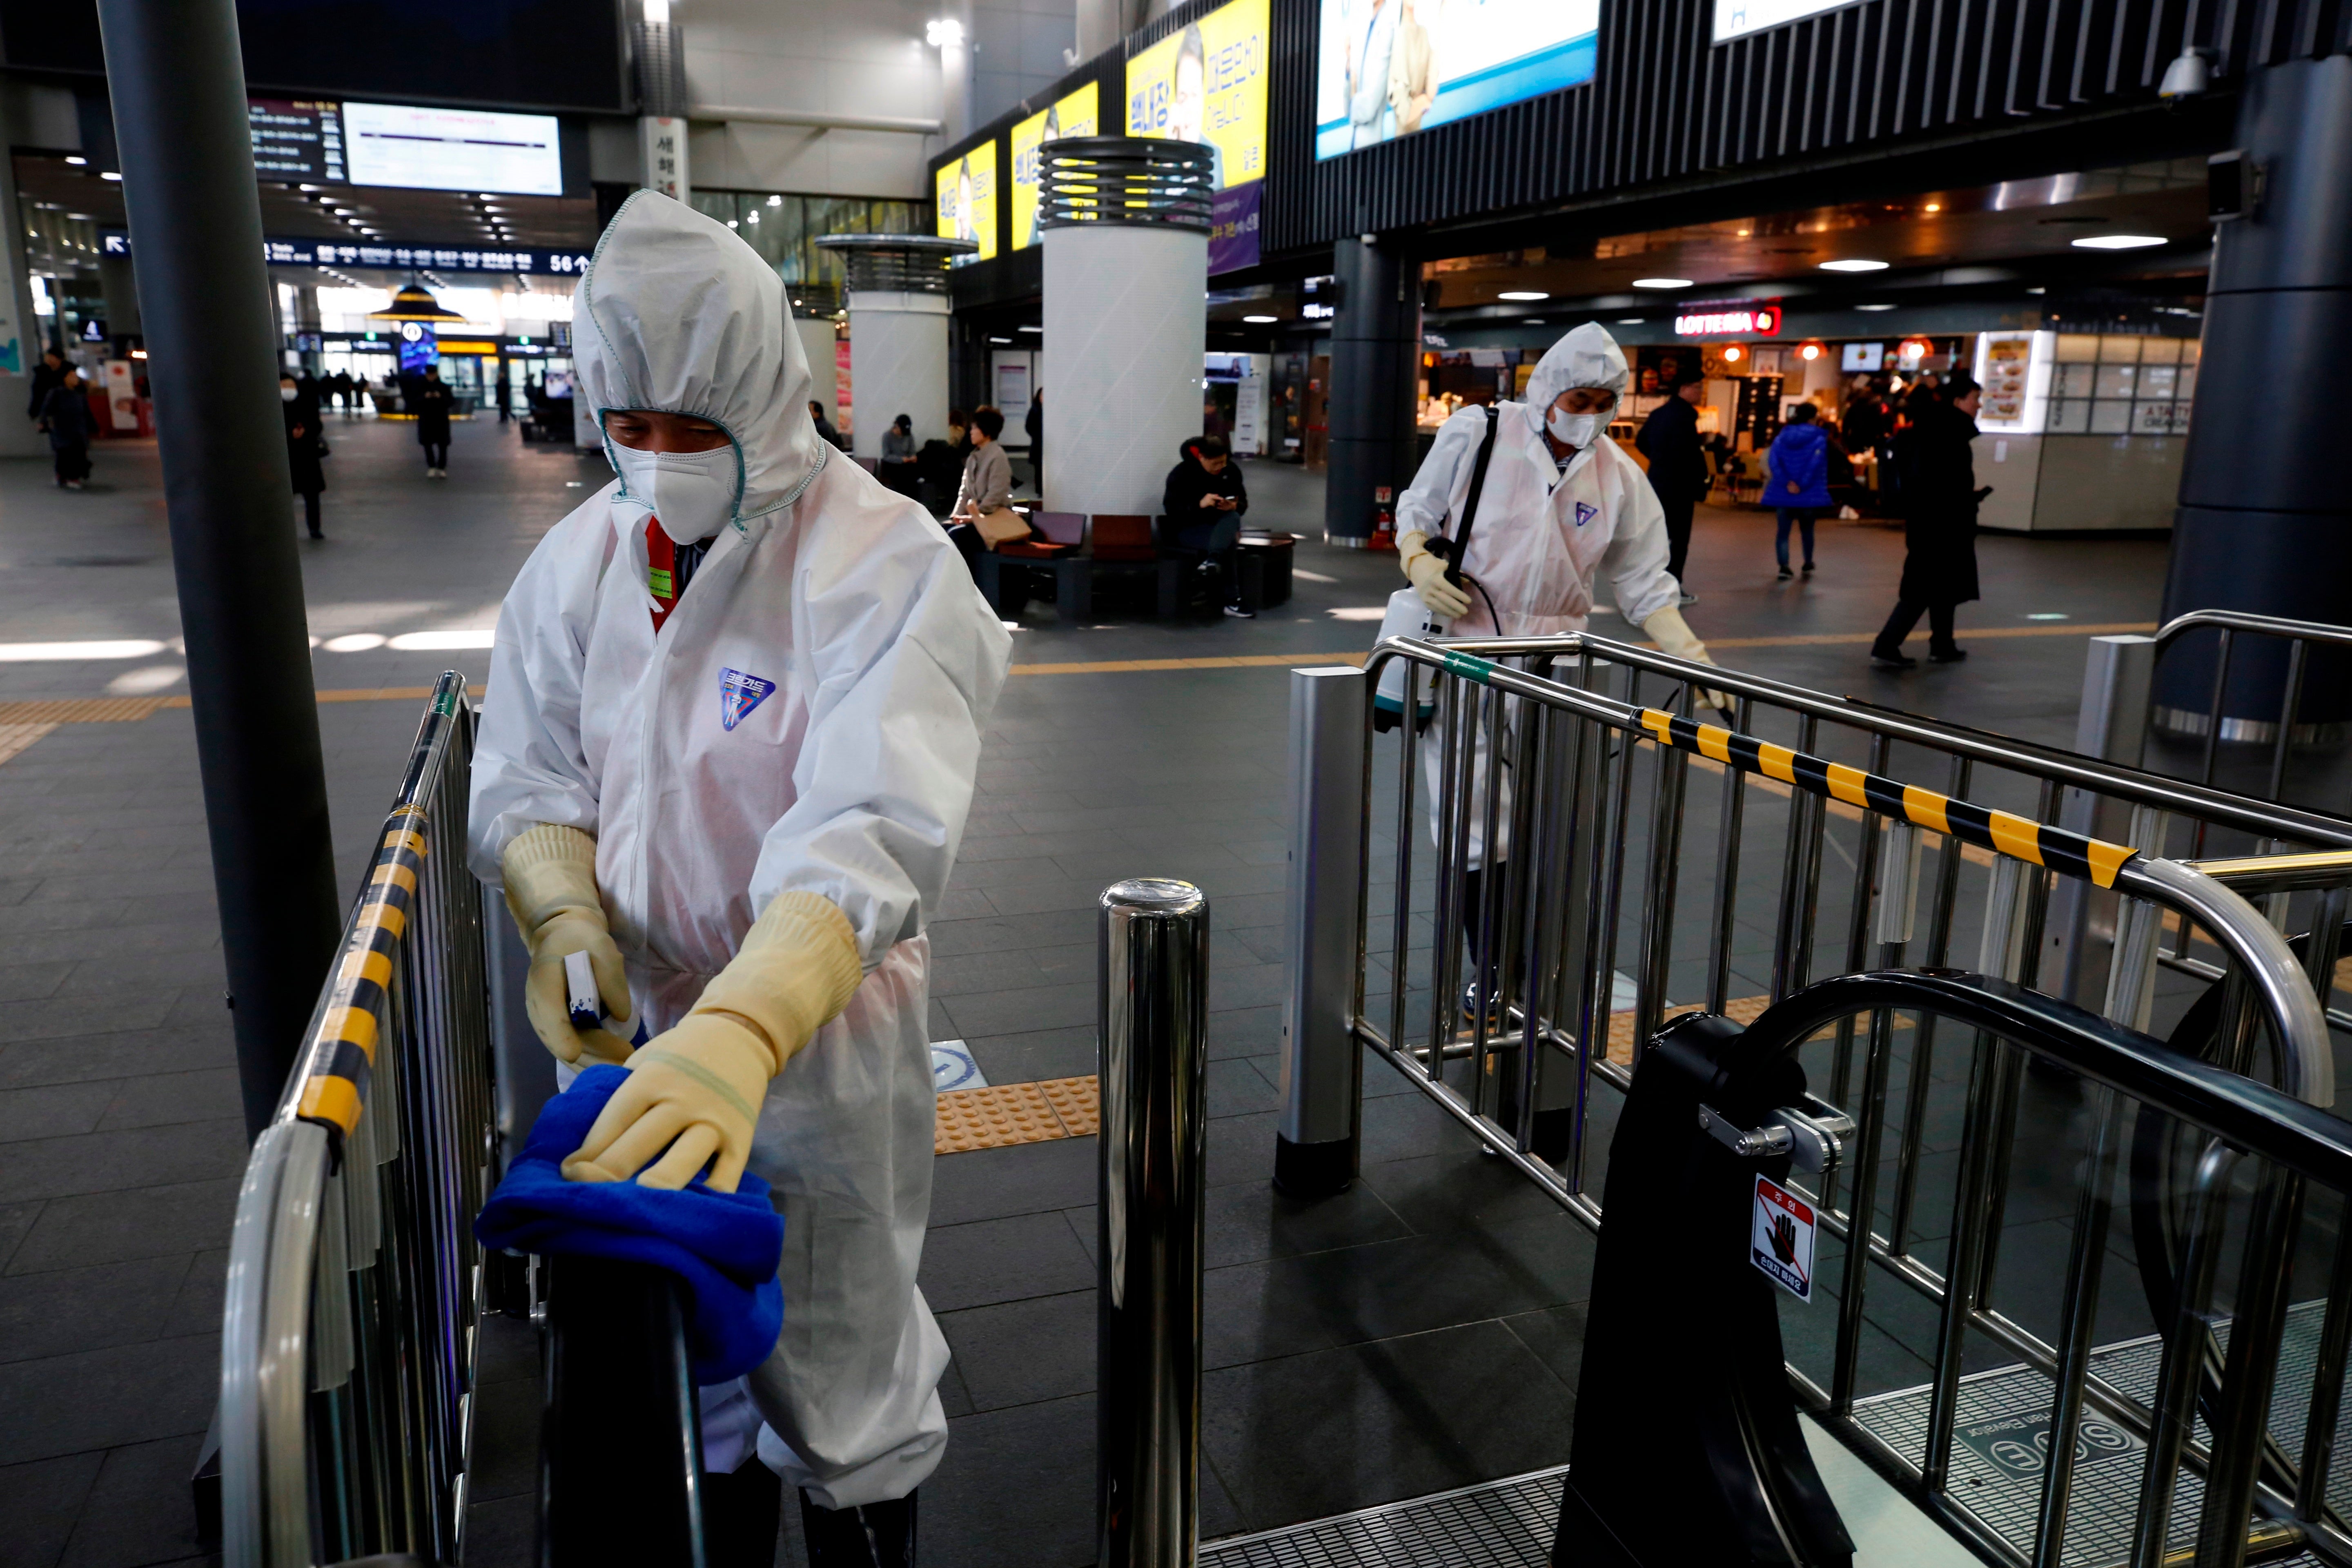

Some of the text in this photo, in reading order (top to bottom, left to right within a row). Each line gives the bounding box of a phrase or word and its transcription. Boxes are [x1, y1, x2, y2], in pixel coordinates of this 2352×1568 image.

[1207, 30, 1264, 95] 때문만이
[1132, 78, 1169, 137] 백내장
[1675, 311, 1753, 336] LOTTERIA
[726, 672, 767, 691] 크린가드
[1760, 1256, 1801, 1291] 손대지 마세요
[1967, 1419, 2028, 1438] Elevator
